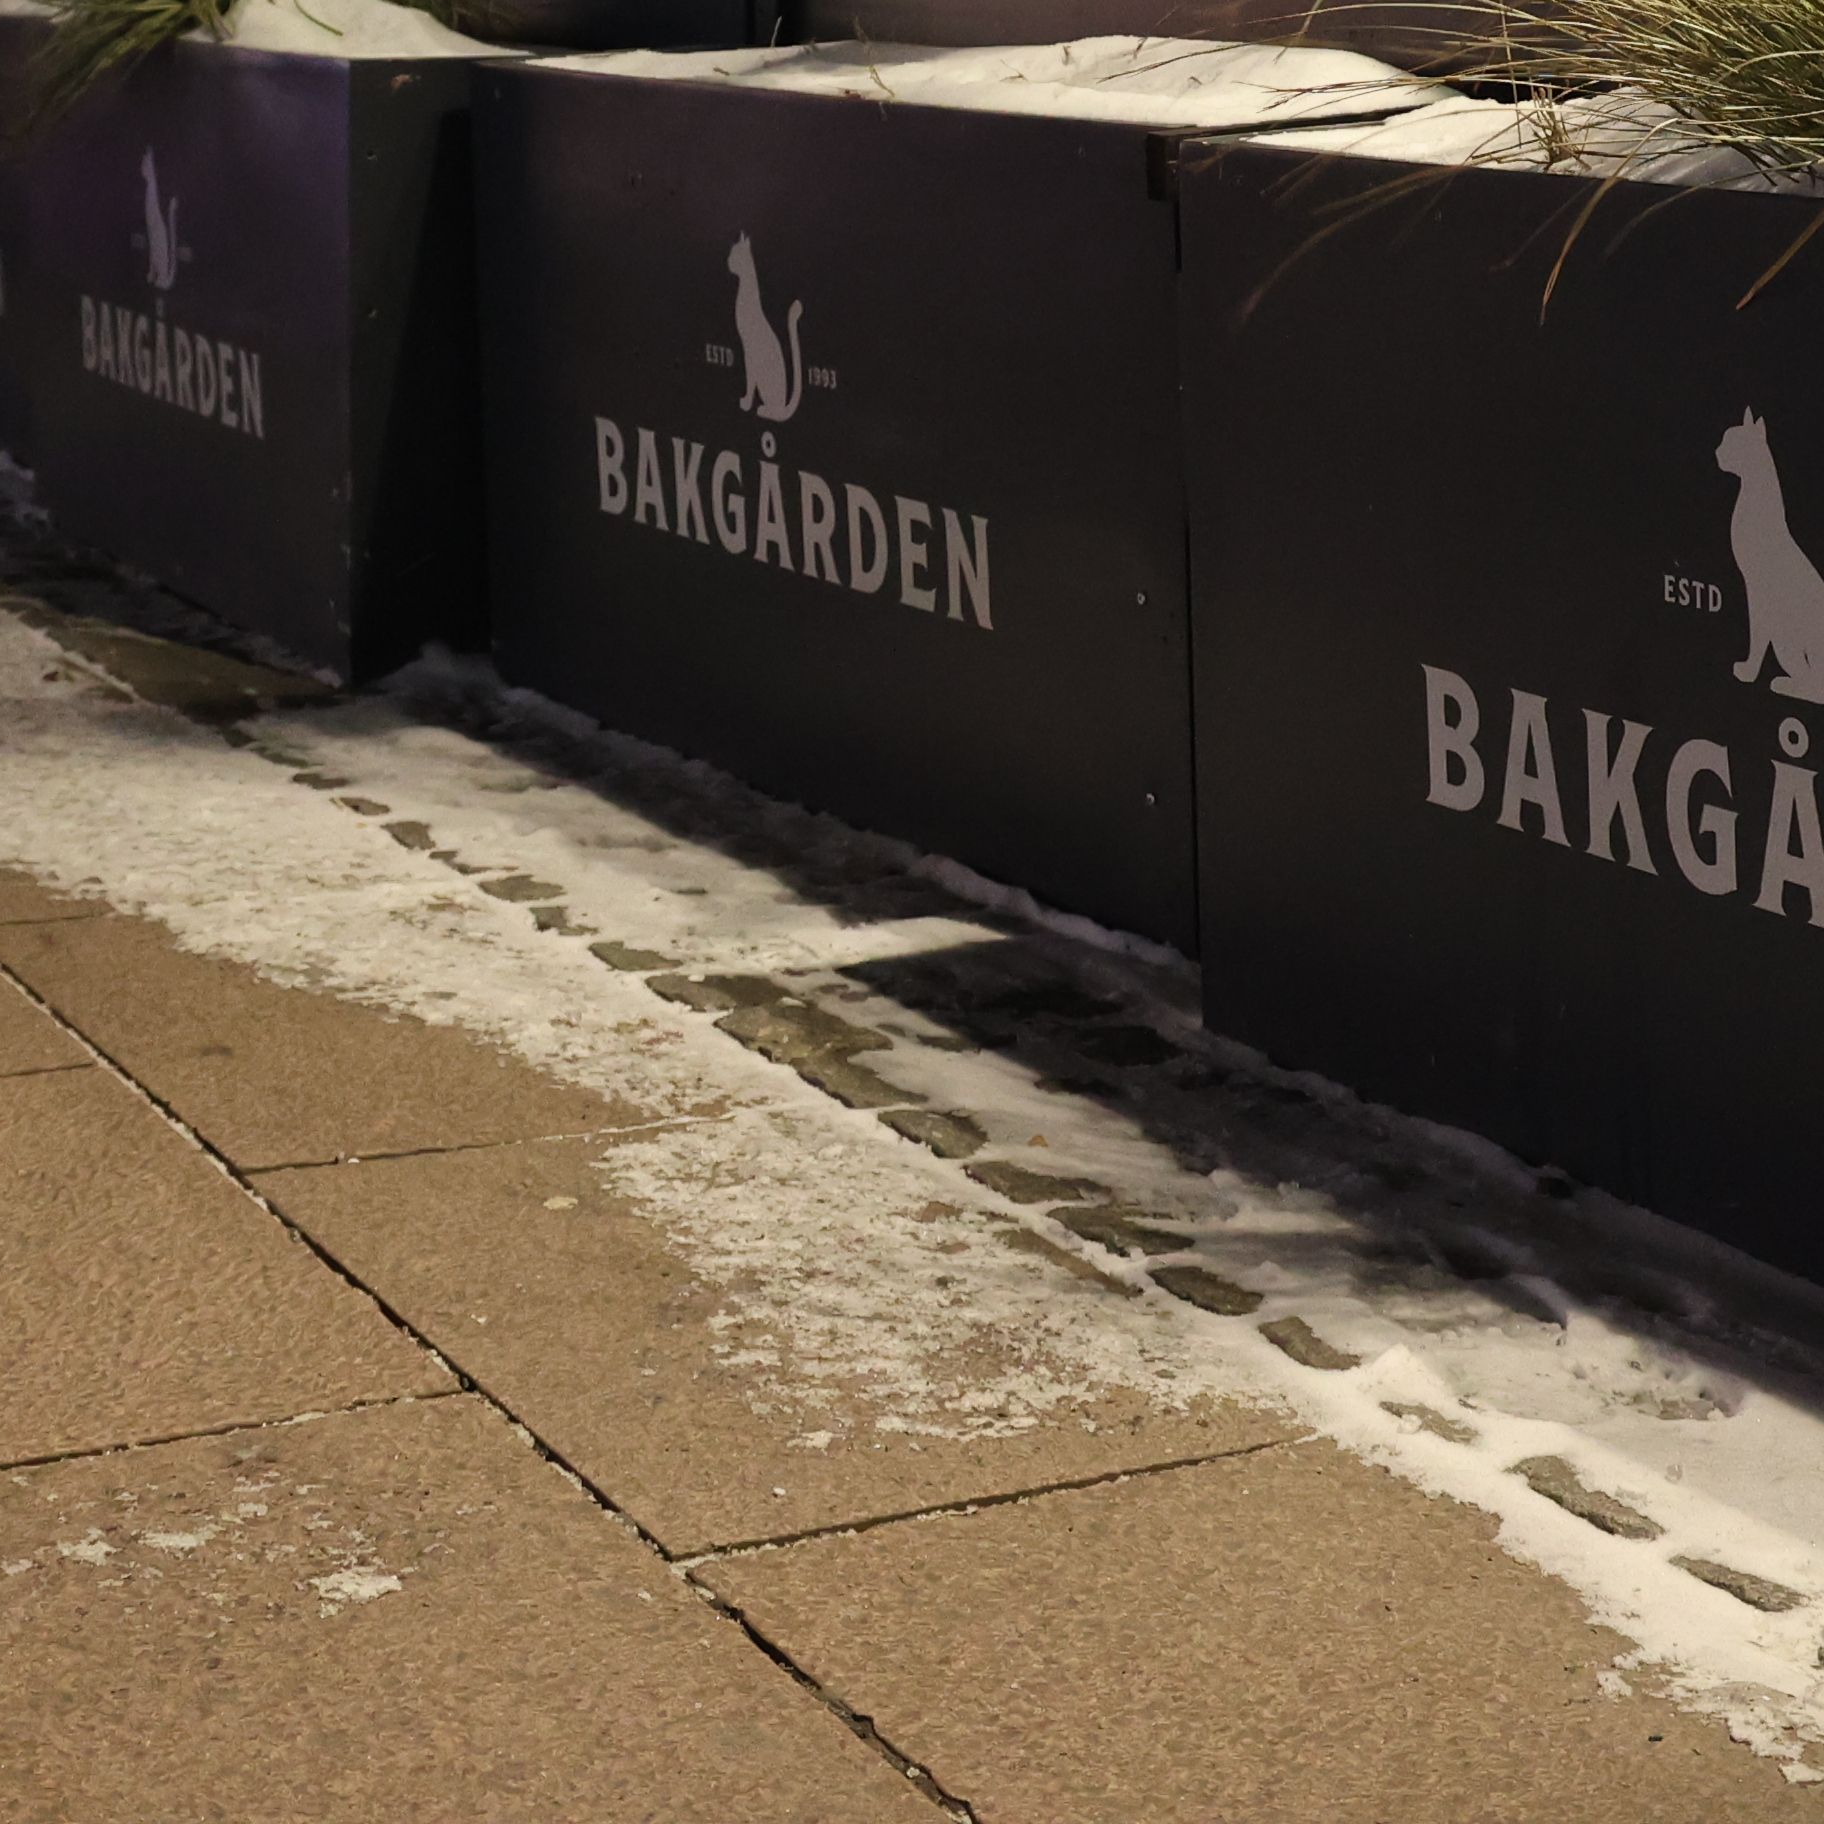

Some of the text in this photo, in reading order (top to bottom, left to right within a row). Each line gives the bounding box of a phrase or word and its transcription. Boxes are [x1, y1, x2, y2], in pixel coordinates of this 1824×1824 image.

[80, 294, 265, 441] BAKGÅRDEN
[705, 343, 838, 390] ESTD 1993
[594, 415, 994, 631] BAKGÅRDEN
[1662, 574, 1723, 614] ESTD
